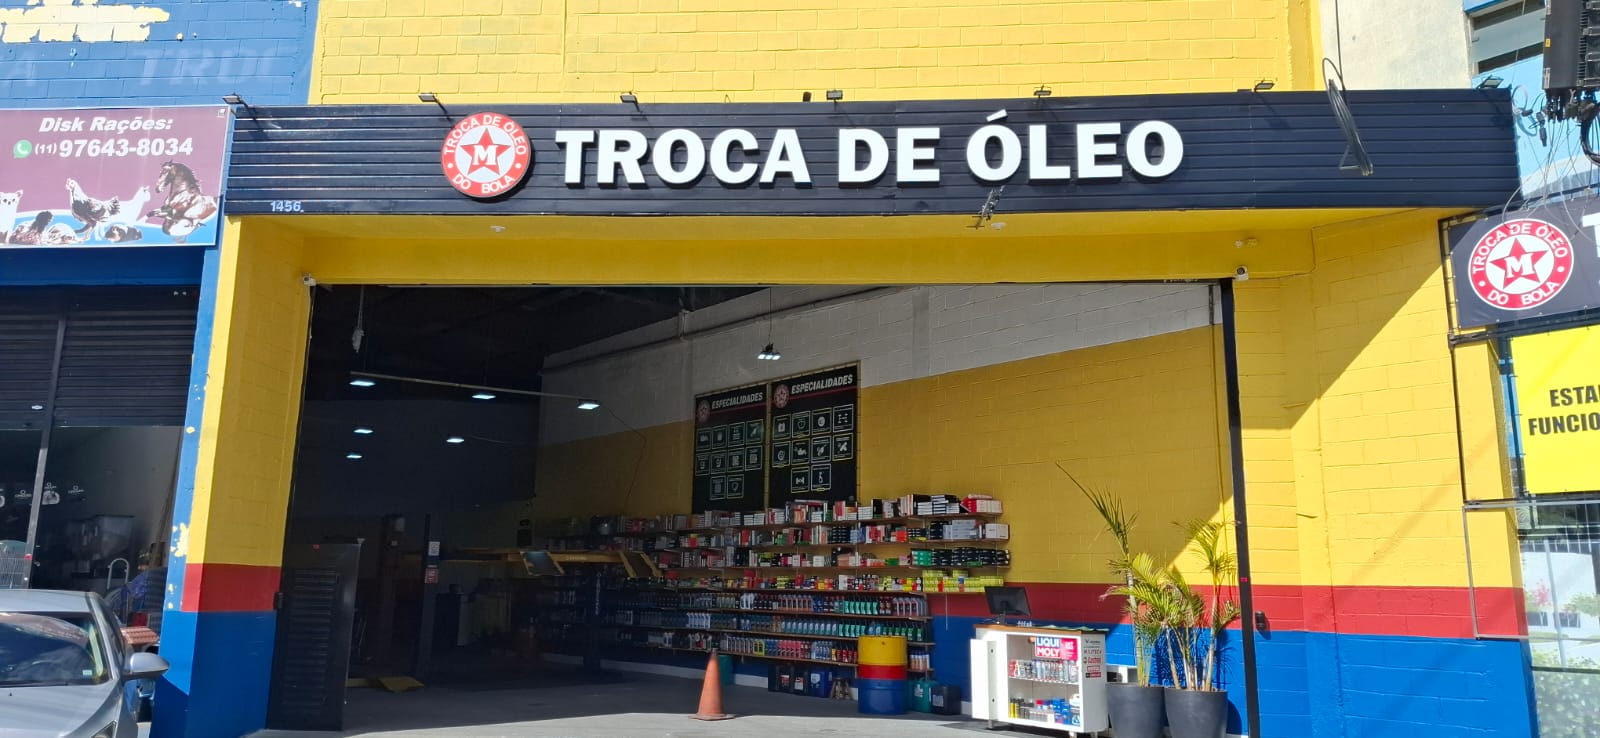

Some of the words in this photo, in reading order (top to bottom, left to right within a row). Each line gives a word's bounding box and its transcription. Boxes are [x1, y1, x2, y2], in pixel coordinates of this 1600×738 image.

[39, 117, 84, 132] Disk
[90, 116, 174, 134] Rações:
[445, 117, 480, 155] TROCA
[482, 114, 502, 127] DE
[503, 121, 527, 155] ÓLEO
[35, 143, 57, 155] (11)
[59, 137, 194, 158] 97643-8034
[472, 145, 498, 165] M
[555, 128, 813, 185] TROCA
[838, 127, 941, 184] DE
[966, 108, 1184, 182] ÓLEO
[453, 173, 471, 190] DO
[481, 175, 515, 194] BOLA
[1472, 229, 1508, 274] TROCA
[1509, 222, 1533, 235] DE
[1504, 253, 1536, 279] M
[1487, 289, 1509, 305] DO
[1520, 281, 1560, 306] BOLA
[791, 374, 853, 395] ESPECIALIDADES
[711, 392, 763, 410] ESPECIALIDADES
[1549, 384, 1600, 407] ESTA
[1528, 412, 1600, 436] FUNCIO
[1036, 636, 1060, 648] LIQUI
[1036, 647, 1060, 658] MOLY
